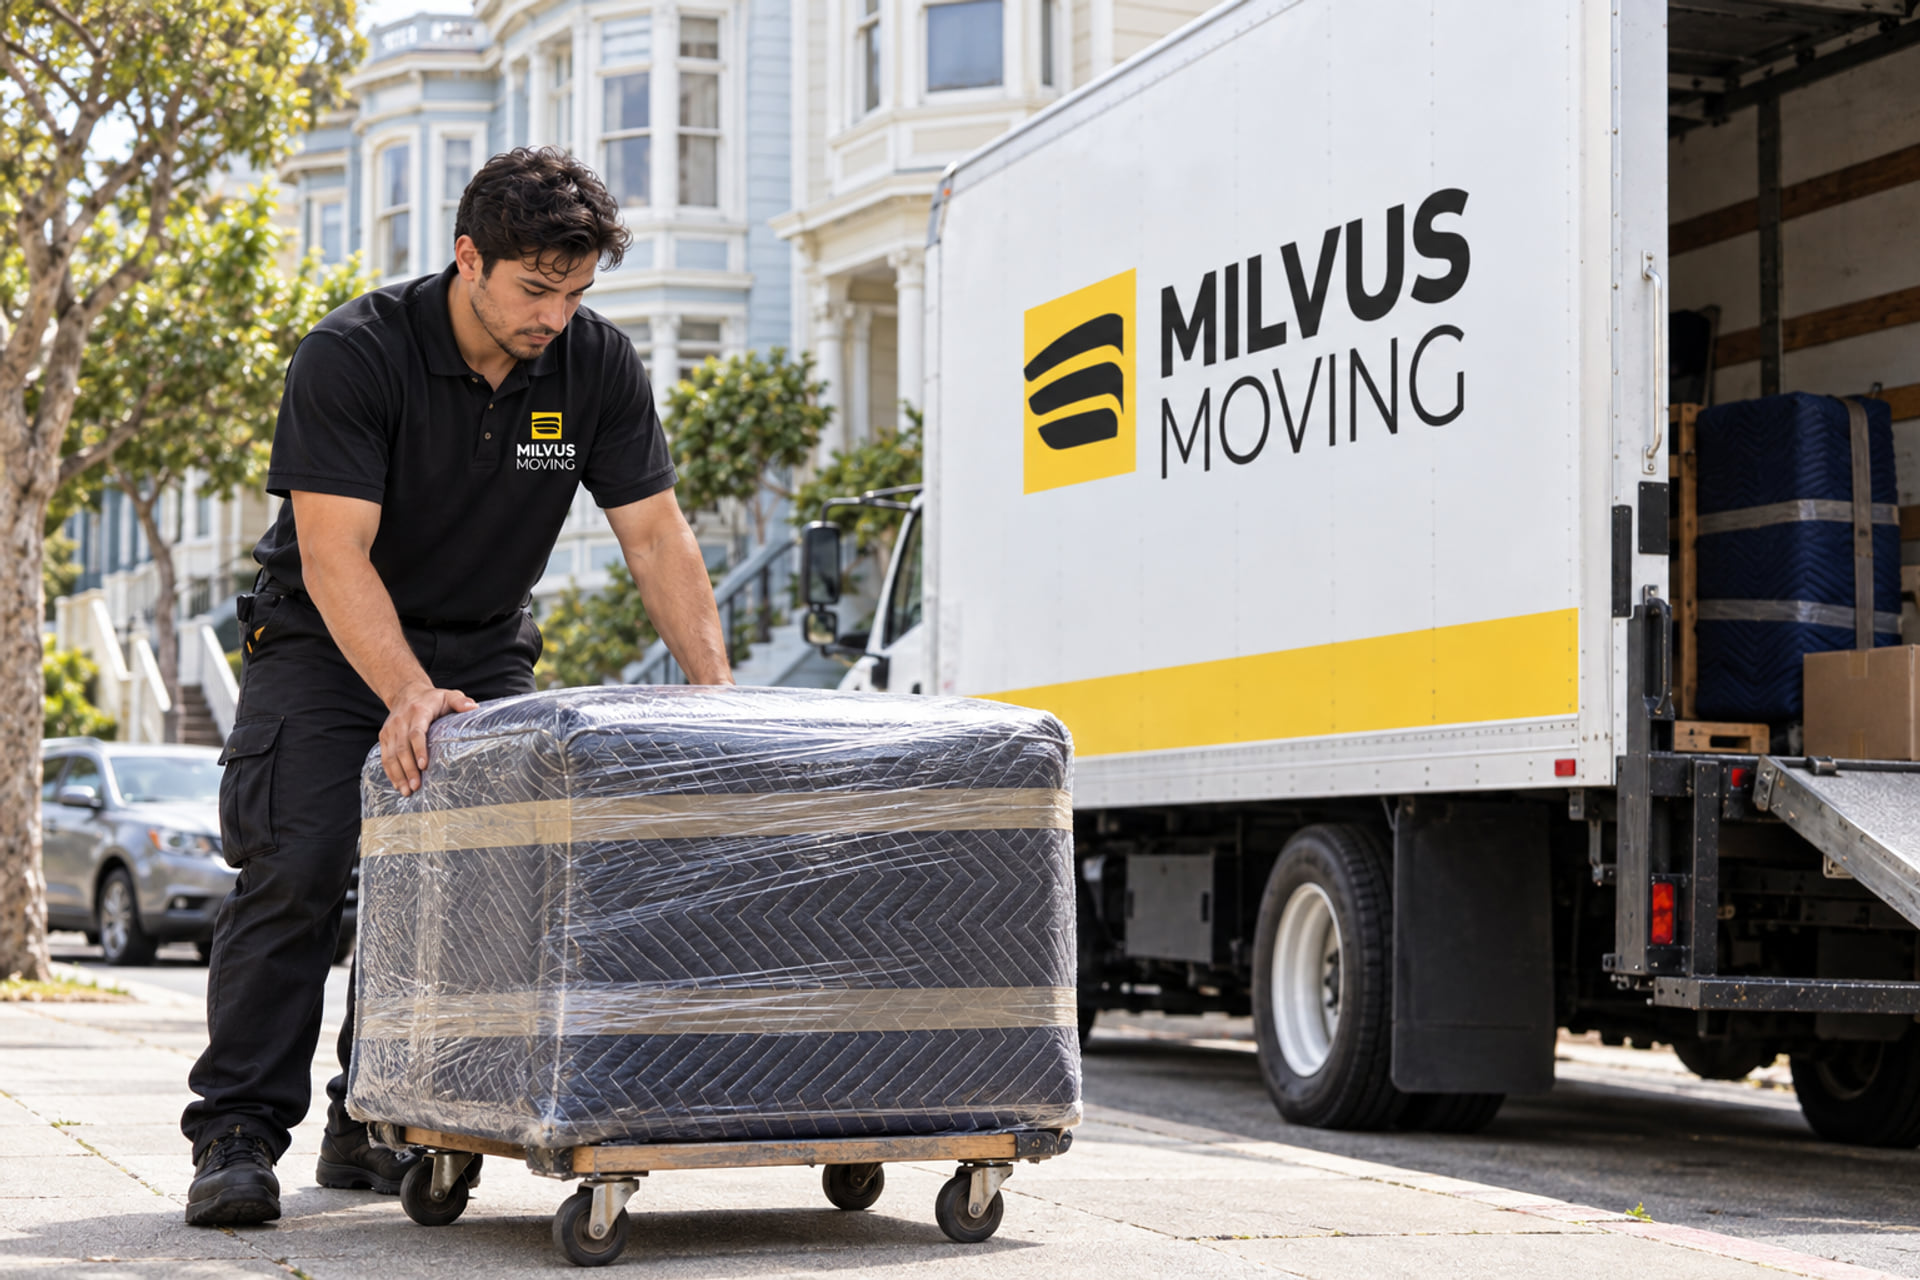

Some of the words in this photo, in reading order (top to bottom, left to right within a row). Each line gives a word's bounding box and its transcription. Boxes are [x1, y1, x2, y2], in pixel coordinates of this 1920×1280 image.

[1161, 188, 1471, 379] MILVUS
[1161, 324, 1465, 480] MOVING
[516, 443, 576, 457] MILVUS
[516, 458, 576, 471] MOVING
